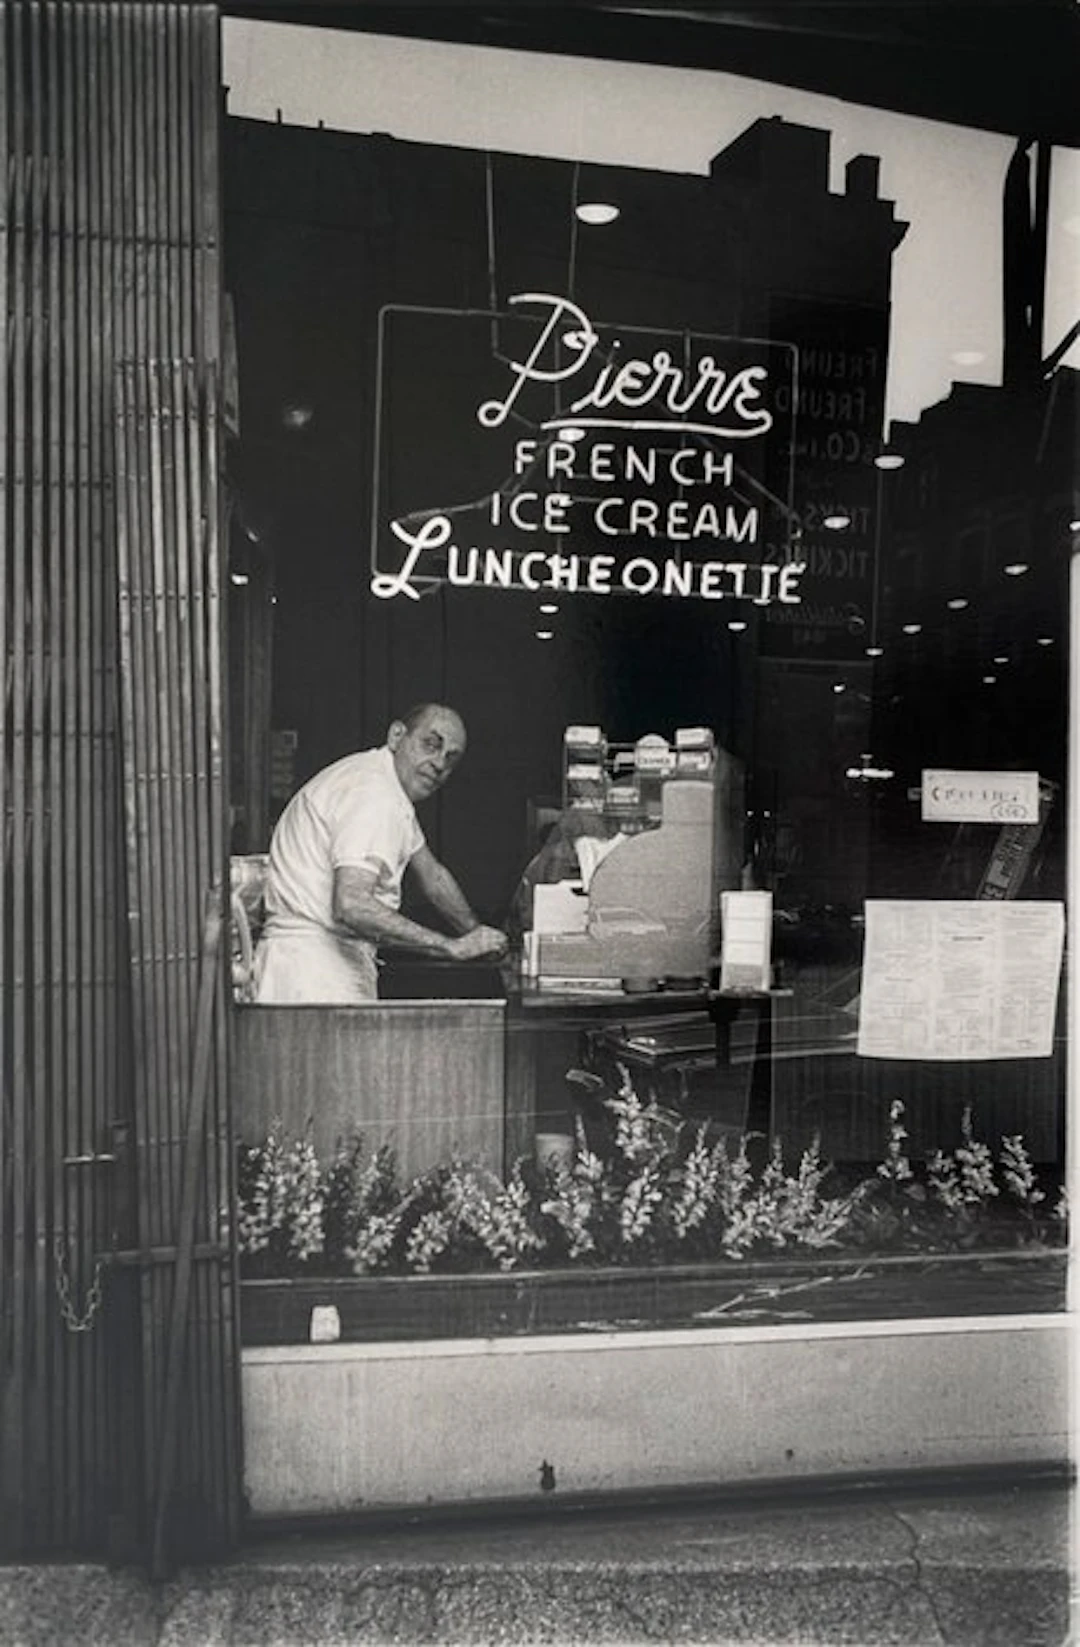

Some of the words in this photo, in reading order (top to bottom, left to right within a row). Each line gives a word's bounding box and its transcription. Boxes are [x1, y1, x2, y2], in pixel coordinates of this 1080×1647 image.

[477, 292, 773, 439] Pierre
[514, 440, 734, 487] FRENCH
[491, 491, 571, 532] ICE
[594, 498, 759, 543] CREAM
[371, 516, 807, 605] LUNCHEONETTE
